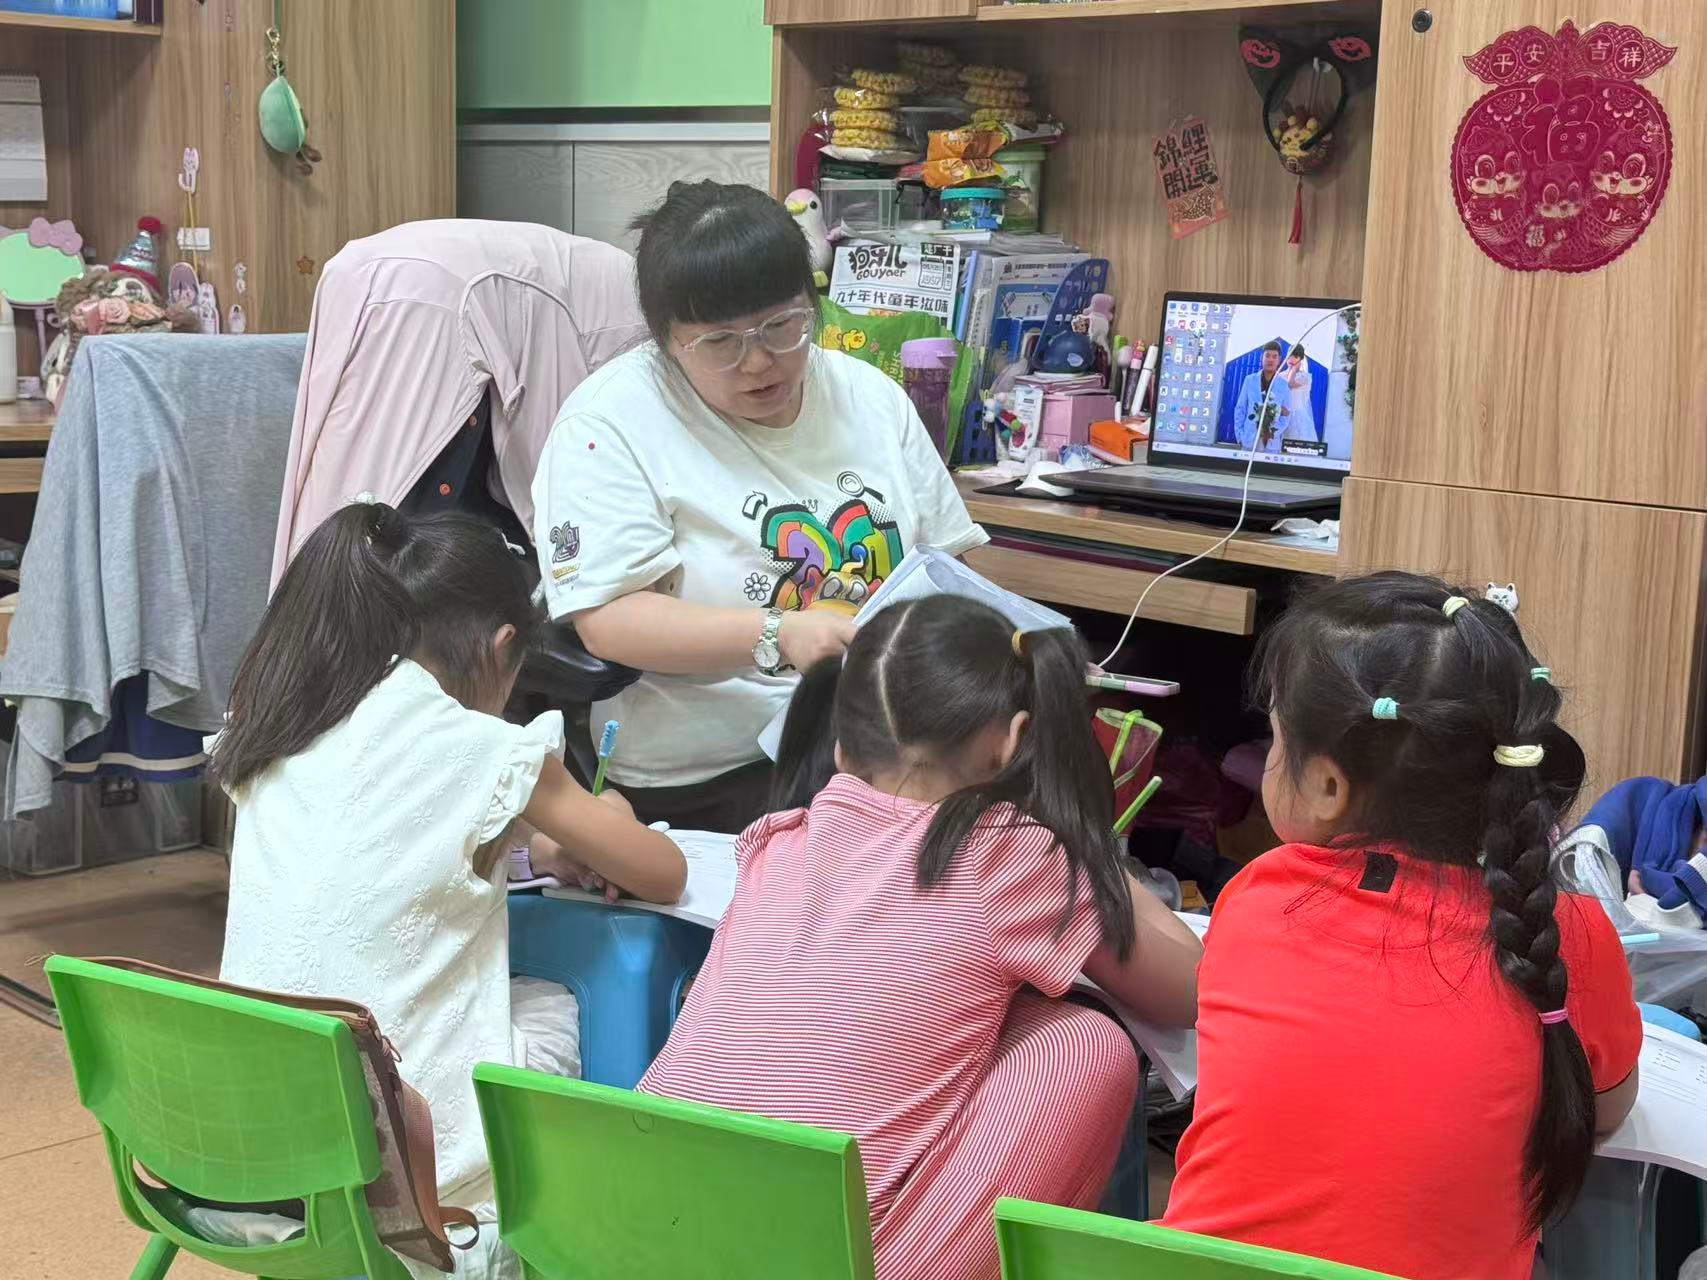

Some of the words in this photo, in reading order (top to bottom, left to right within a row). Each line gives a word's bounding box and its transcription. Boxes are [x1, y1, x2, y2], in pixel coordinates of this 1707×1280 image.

[1493, 40, 1642, 73] 平安吉祥
[836, 289, 949, 313] 九十年代童年滋味
